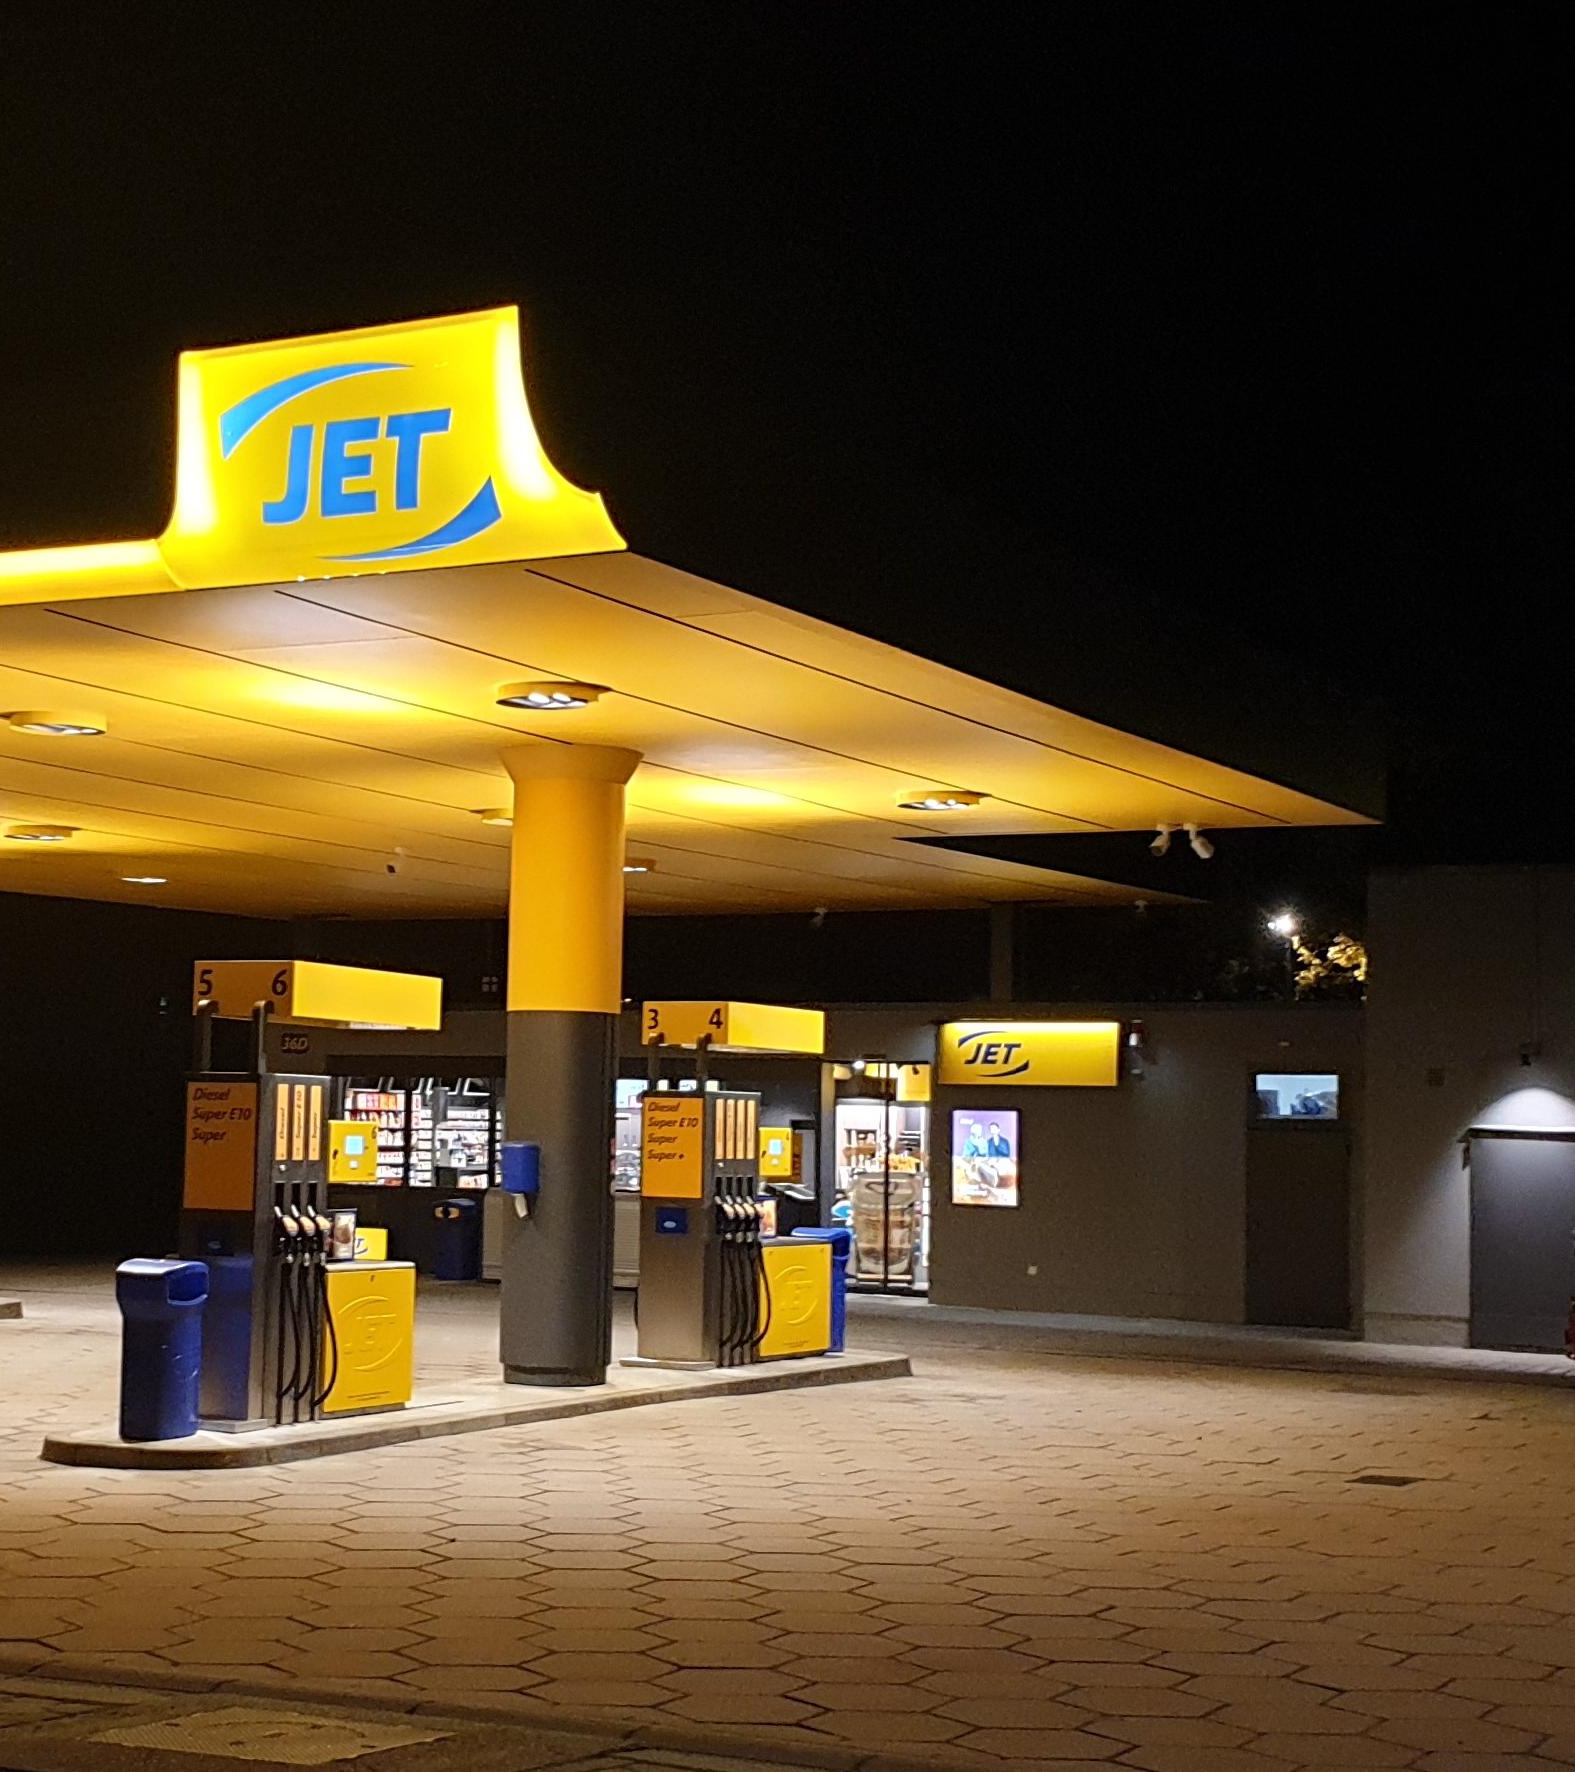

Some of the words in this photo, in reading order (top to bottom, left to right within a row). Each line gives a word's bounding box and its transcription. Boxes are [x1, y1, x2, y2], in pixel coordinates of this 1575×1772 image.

[262, 408, 452, 525] JET
[198, 969, 213, 996] 5
[272, 969, 288, 996] 6
[648, 1009, 659, 1029] 3
[709, 1008, 723, 1029] 4
[964, 1043, 1022, 1065] JET
[193, 1088, 230, 1101] Diesel
[192, 1107, 226, 1122] Super
[229, 1108, 252, 1121] E10
[648, 1102, 680, 1112] Diesel
[648, 1117, 678, 1129] Super
[679, 1117, 699, 1127] E10
[192, 1128, 226, 1144] Super
[648, 1133, 678, 1145] Super
[648, 1150, 677, 1161] Super
